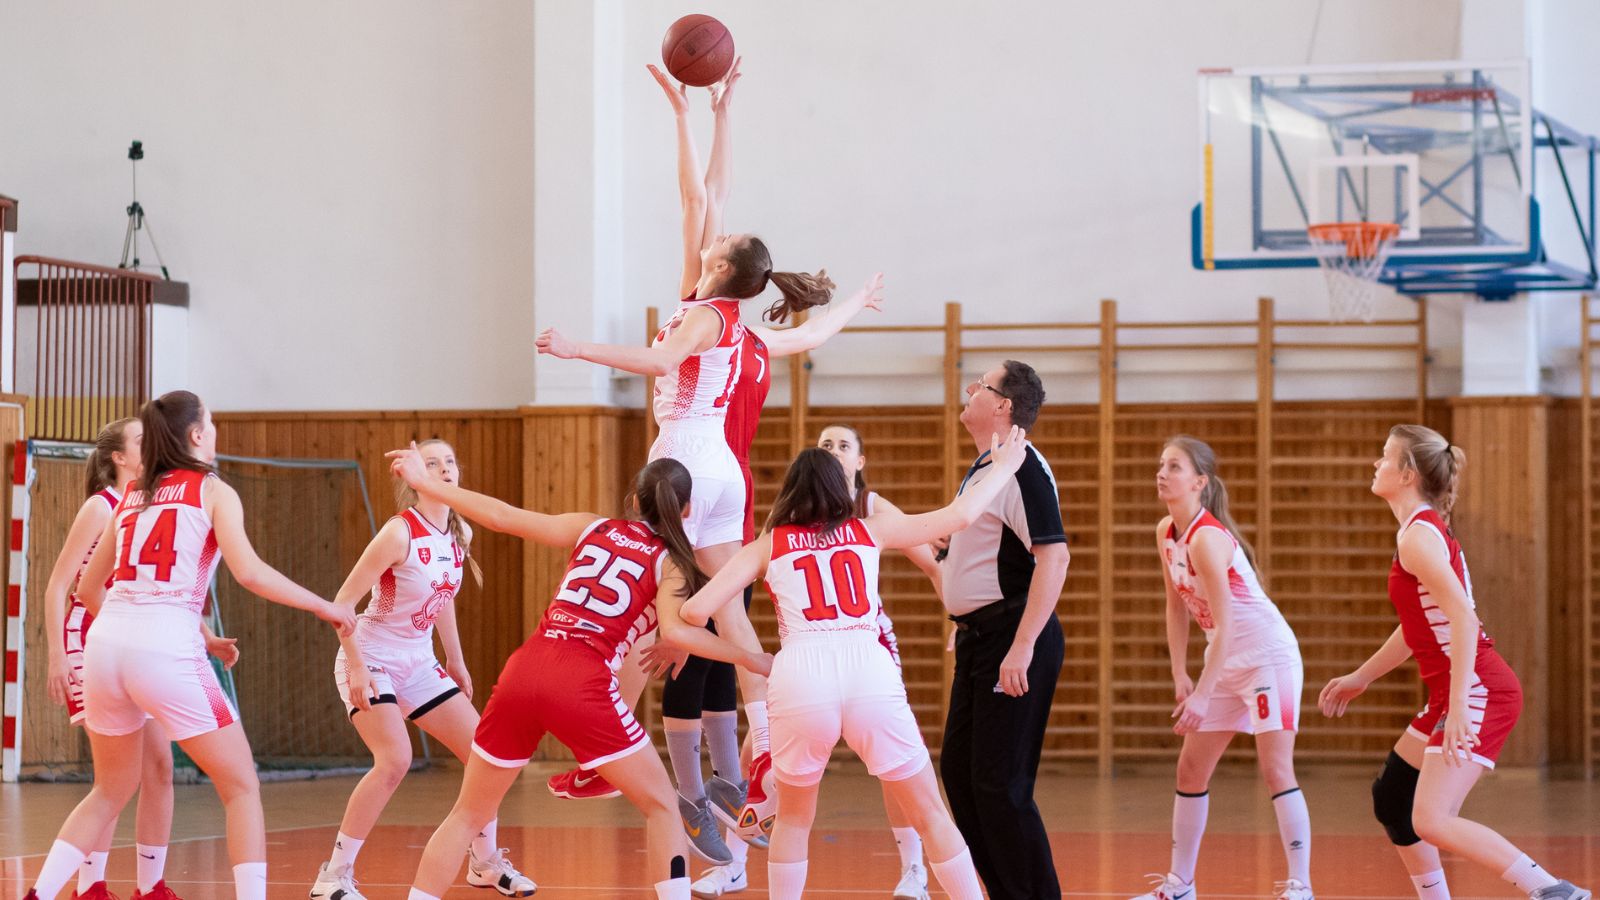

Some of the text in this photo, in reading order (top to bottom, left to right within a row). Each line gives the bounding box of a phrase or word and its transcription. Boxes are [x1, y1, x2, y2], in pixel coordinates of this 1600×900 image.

[114, 508, 178, 582] 14
[605, 527, 658, 556] legrand
[555, 543, 646, 618] 25
[792, 548, 871, 622] 10
[1257, 693, 1270, 720] 8
